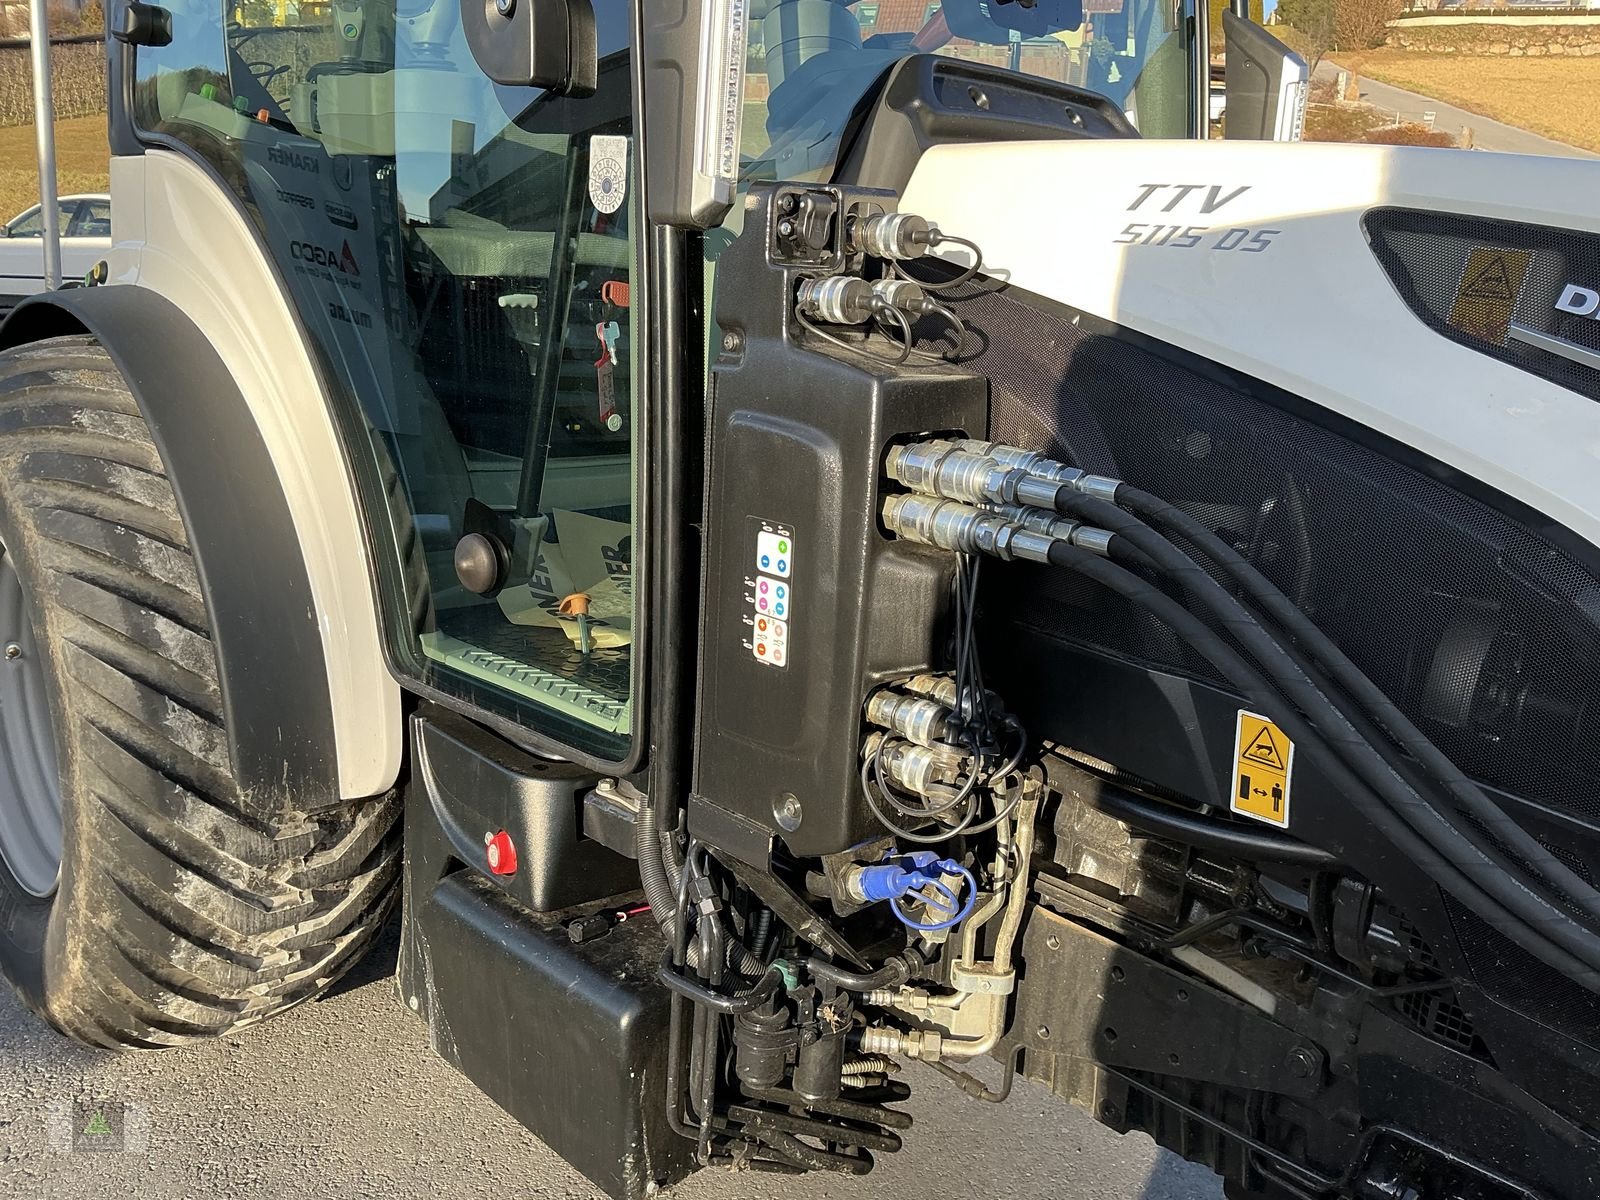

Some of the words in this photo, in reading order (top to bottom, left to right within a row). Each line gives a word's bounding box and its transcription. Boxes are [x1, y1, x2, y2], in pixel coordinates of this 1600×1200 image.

[1126, 184, 1252, 214] TTV
[1112, 223, 1209, 248] 5115
[1555, 283, 1600, 320] D
